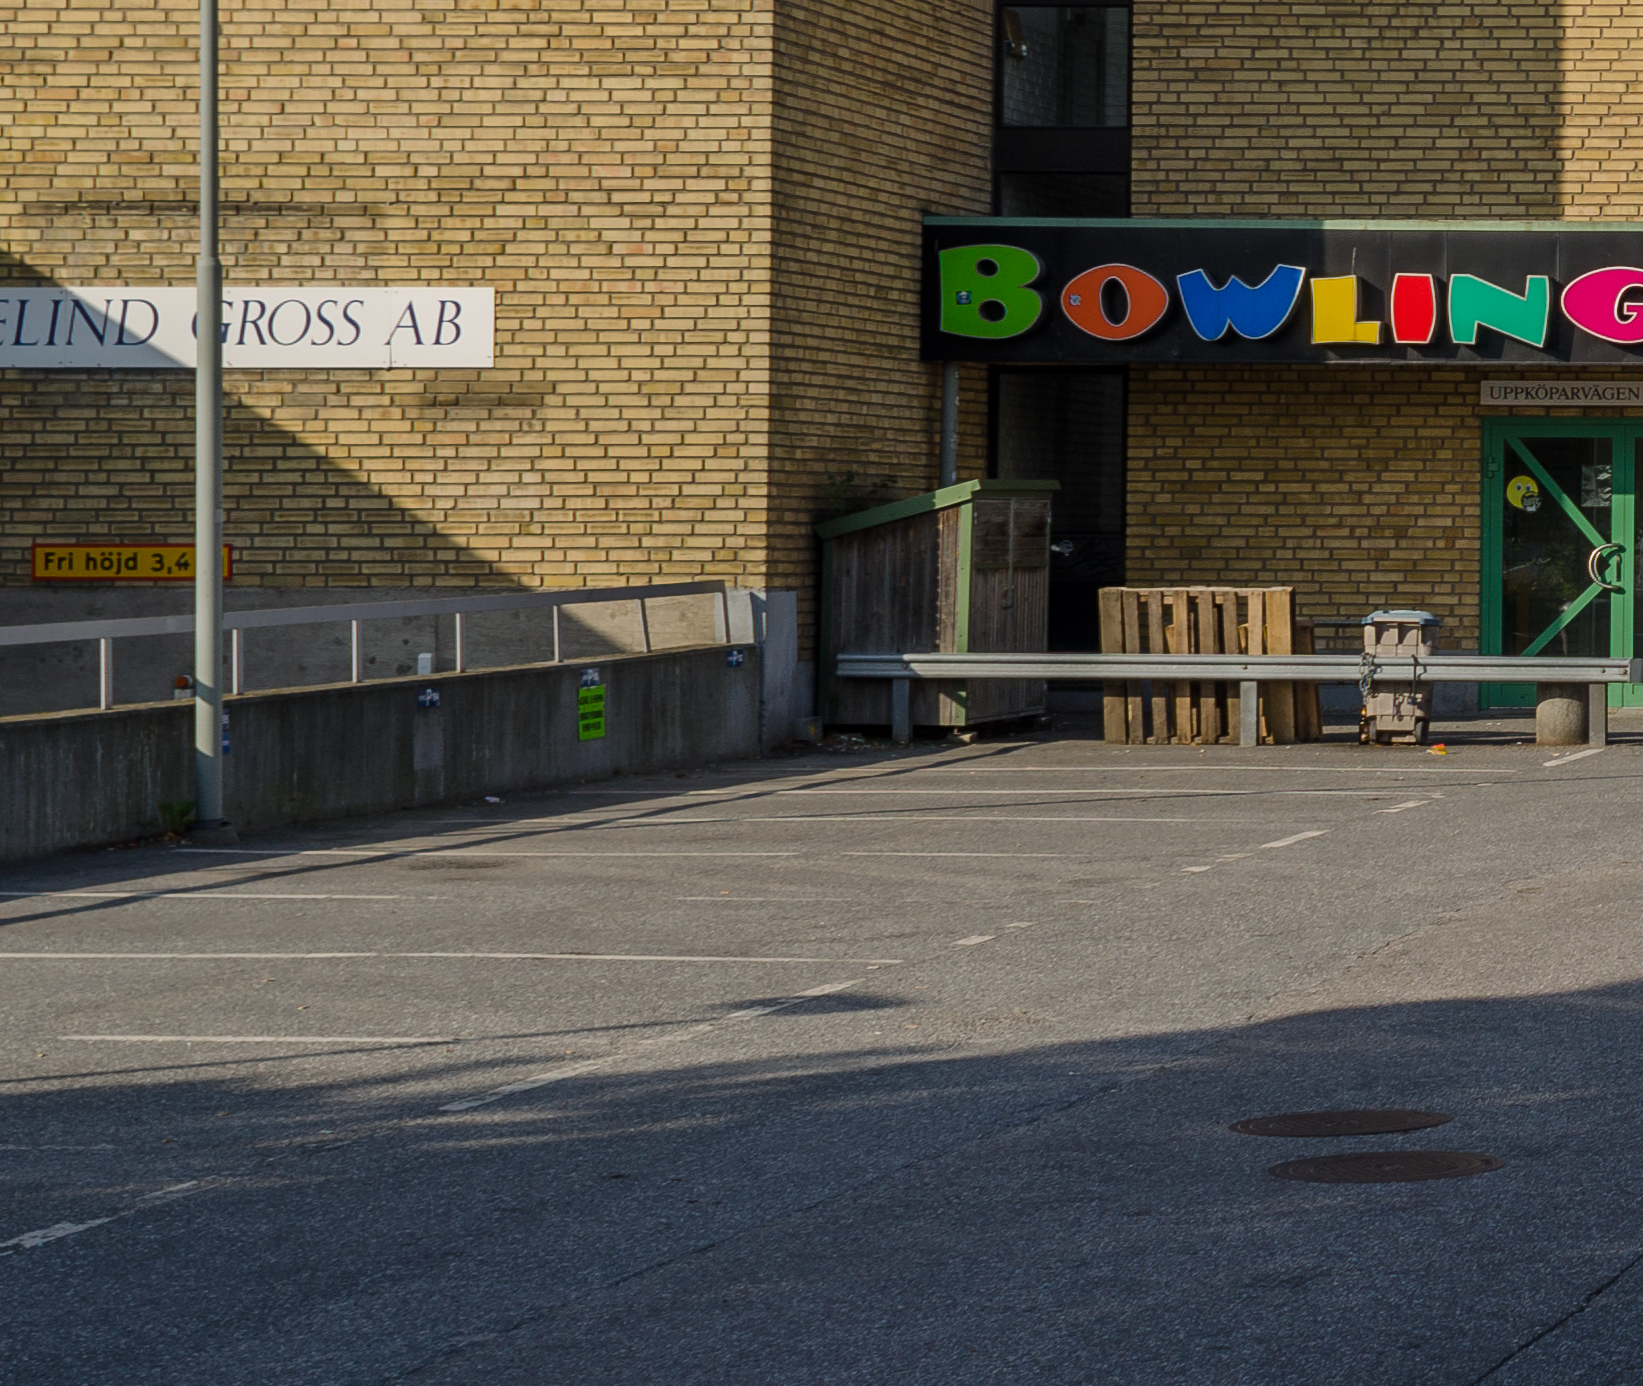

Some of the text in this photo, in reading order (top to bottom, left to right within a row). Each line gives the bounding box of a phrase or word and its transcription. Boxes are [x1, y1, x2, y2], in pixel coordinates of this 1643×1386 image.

[384, 298, 463, 347] AB
[1489, 384, 1641, 400] UPPKÖPARVÄGEN
[43, 551, 191, 576] Fri höjd 3,4
